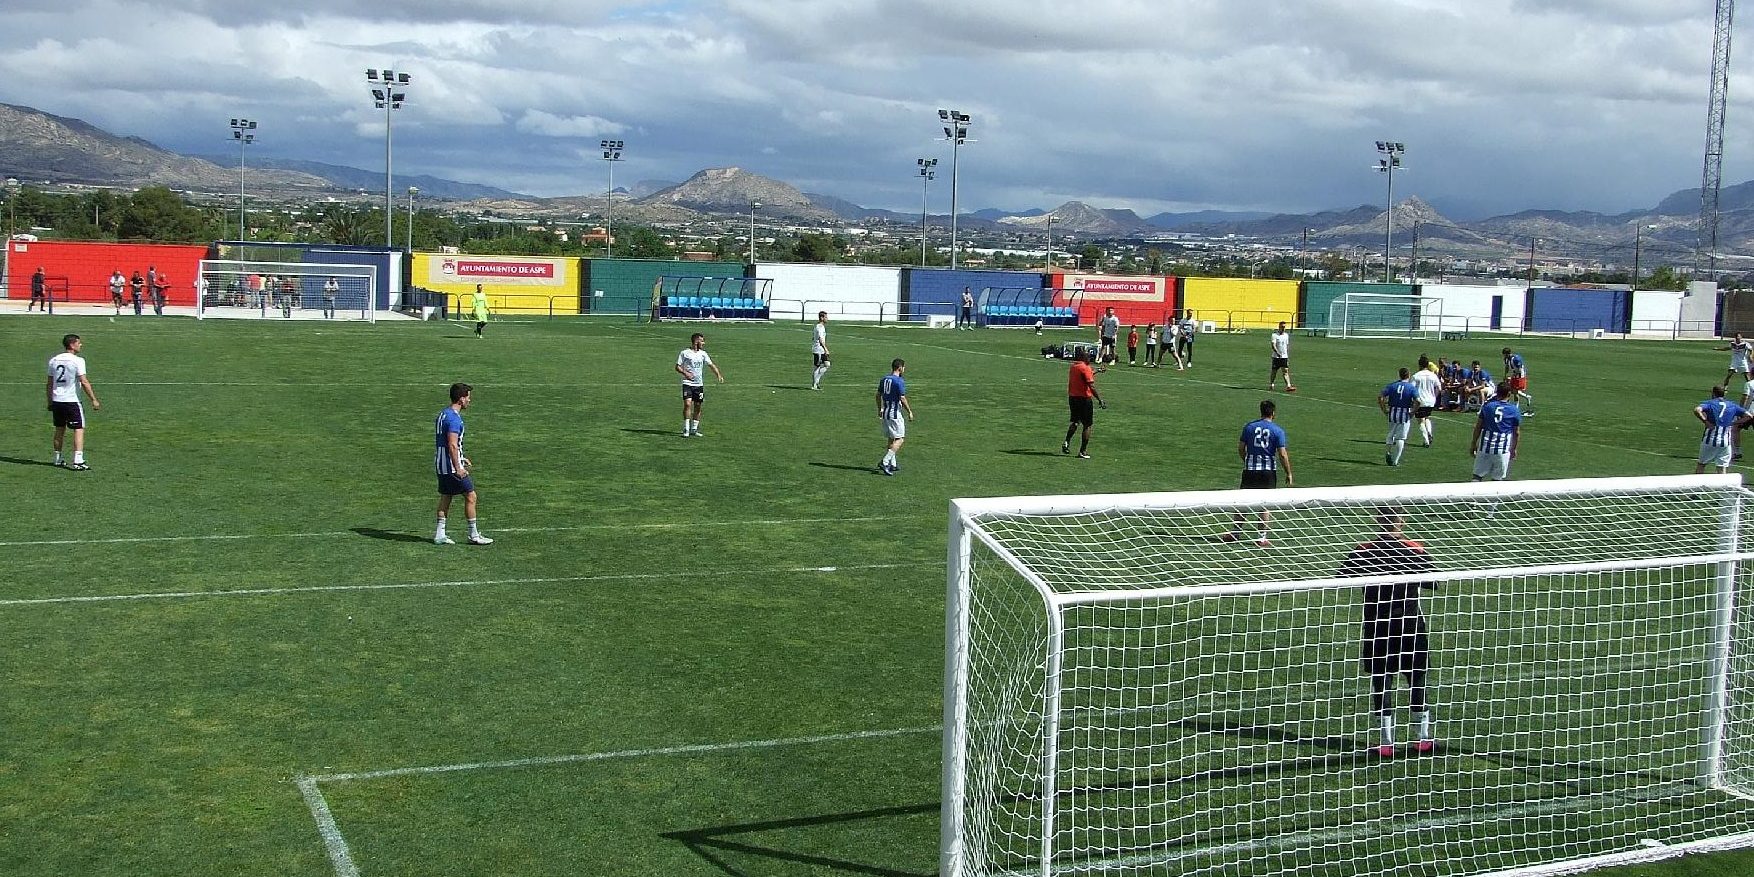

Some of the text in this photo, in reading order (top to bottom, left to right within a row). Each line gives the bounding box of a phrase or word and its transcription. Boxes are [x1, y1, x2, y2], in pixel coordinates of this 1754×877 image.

[460, 265, 546, 274] AYUNTAMIENTO DE ASPE
[56, 364, 67, 383] 2
[883, 378, 893, 395] 10
[1396, 384, 1405, 400] 4
[1494, 406, 1505, 423] 5
[1718, 401, 1727, 418] 7
[1253, 426, 1271, 448] 23
